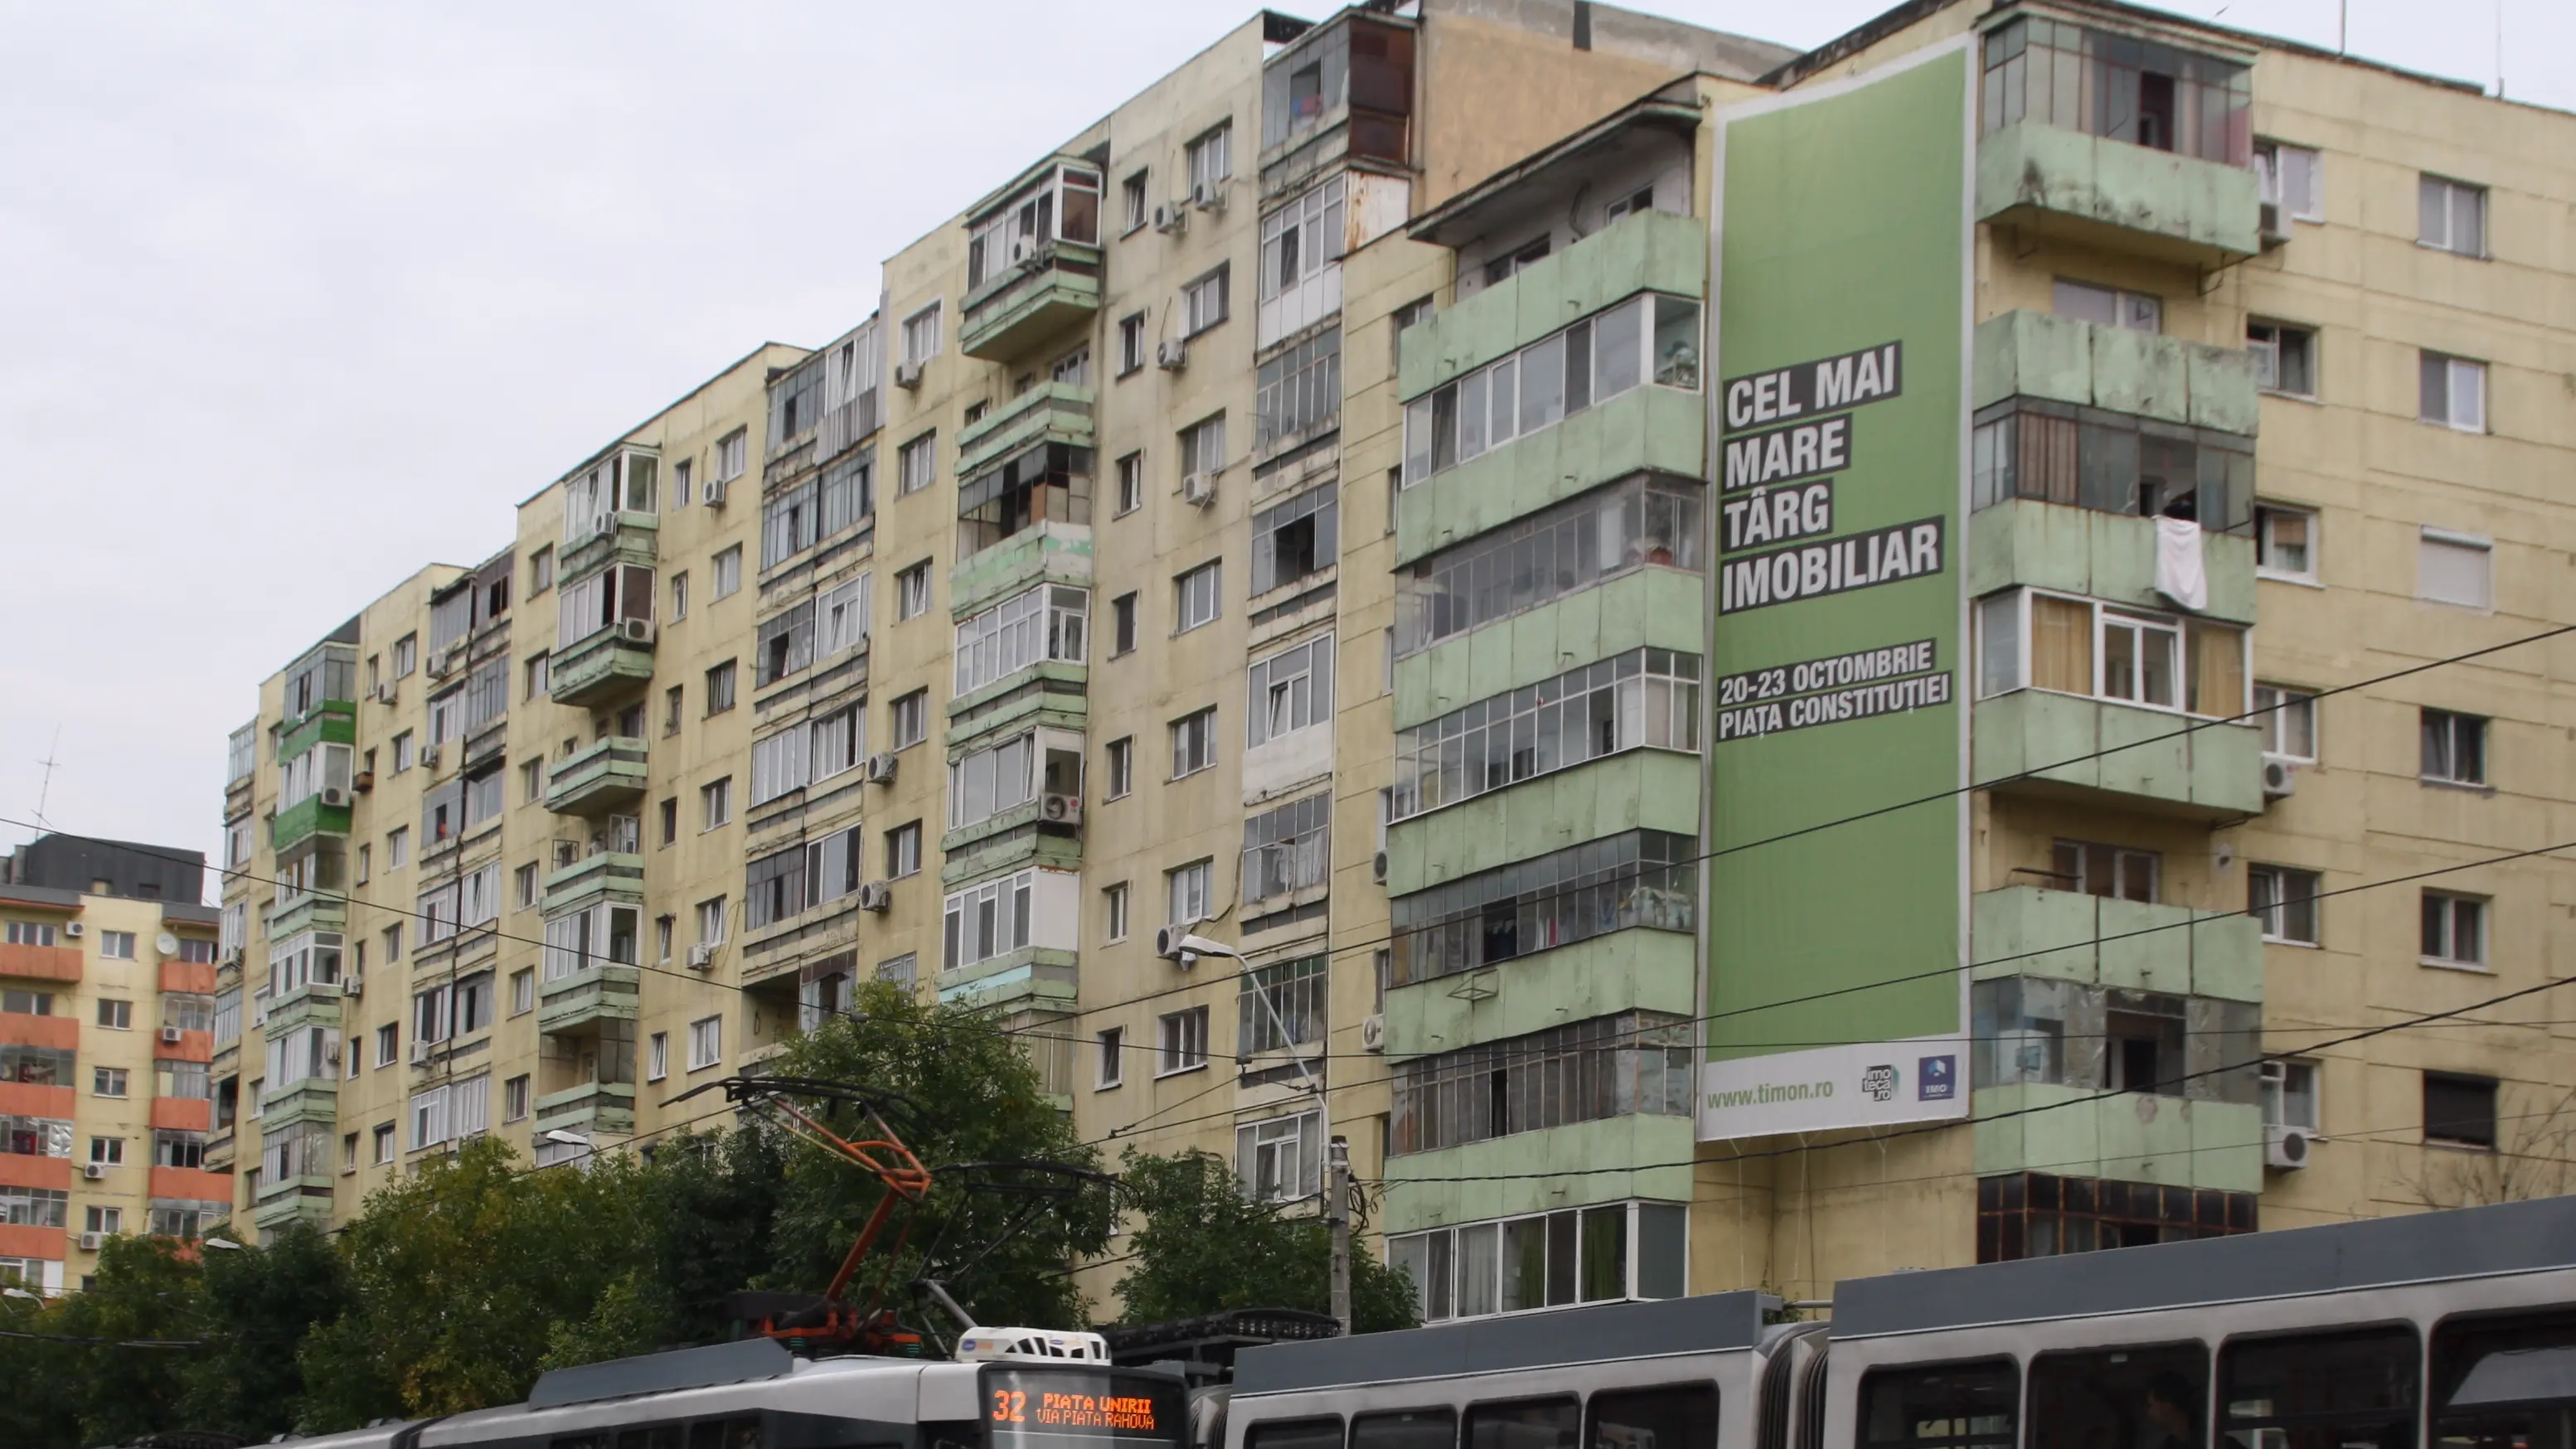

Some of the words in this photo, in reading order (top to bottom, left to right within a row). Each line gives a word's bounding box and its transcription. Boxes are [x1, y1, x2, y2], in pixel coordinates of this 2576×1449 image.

[1728, 370, 1802, 429] CEL
[1814, 344, 1895, 410] MAI
[1725, 419, 1846, 491] MARE
[1724, 486, 1829, 549] TÂRG
[1722, 523, 1939, 611] IMOBILIAR
[1720, 669, 1786, 705] 20-23
[1793, 641, 1933, 692] OCTOMBRIE
[1863, 1079, 1890, 1091] teca
[1867, 1067, 1890, 1080] imo
[1707, 1080, 1834, 1109] www.timon.ro
[993, 1390, 1026, 1422] 32
[1036, 1408, 1060, 1424] VIA
[1063, 1410, 1101, 1427] PIATA
[1105, 1413, 1155, 1430] RAHOVA
[1043, 1393, 1094, 1411] PIATA
[1099, 1397, 1152, 1414] UNIRII
